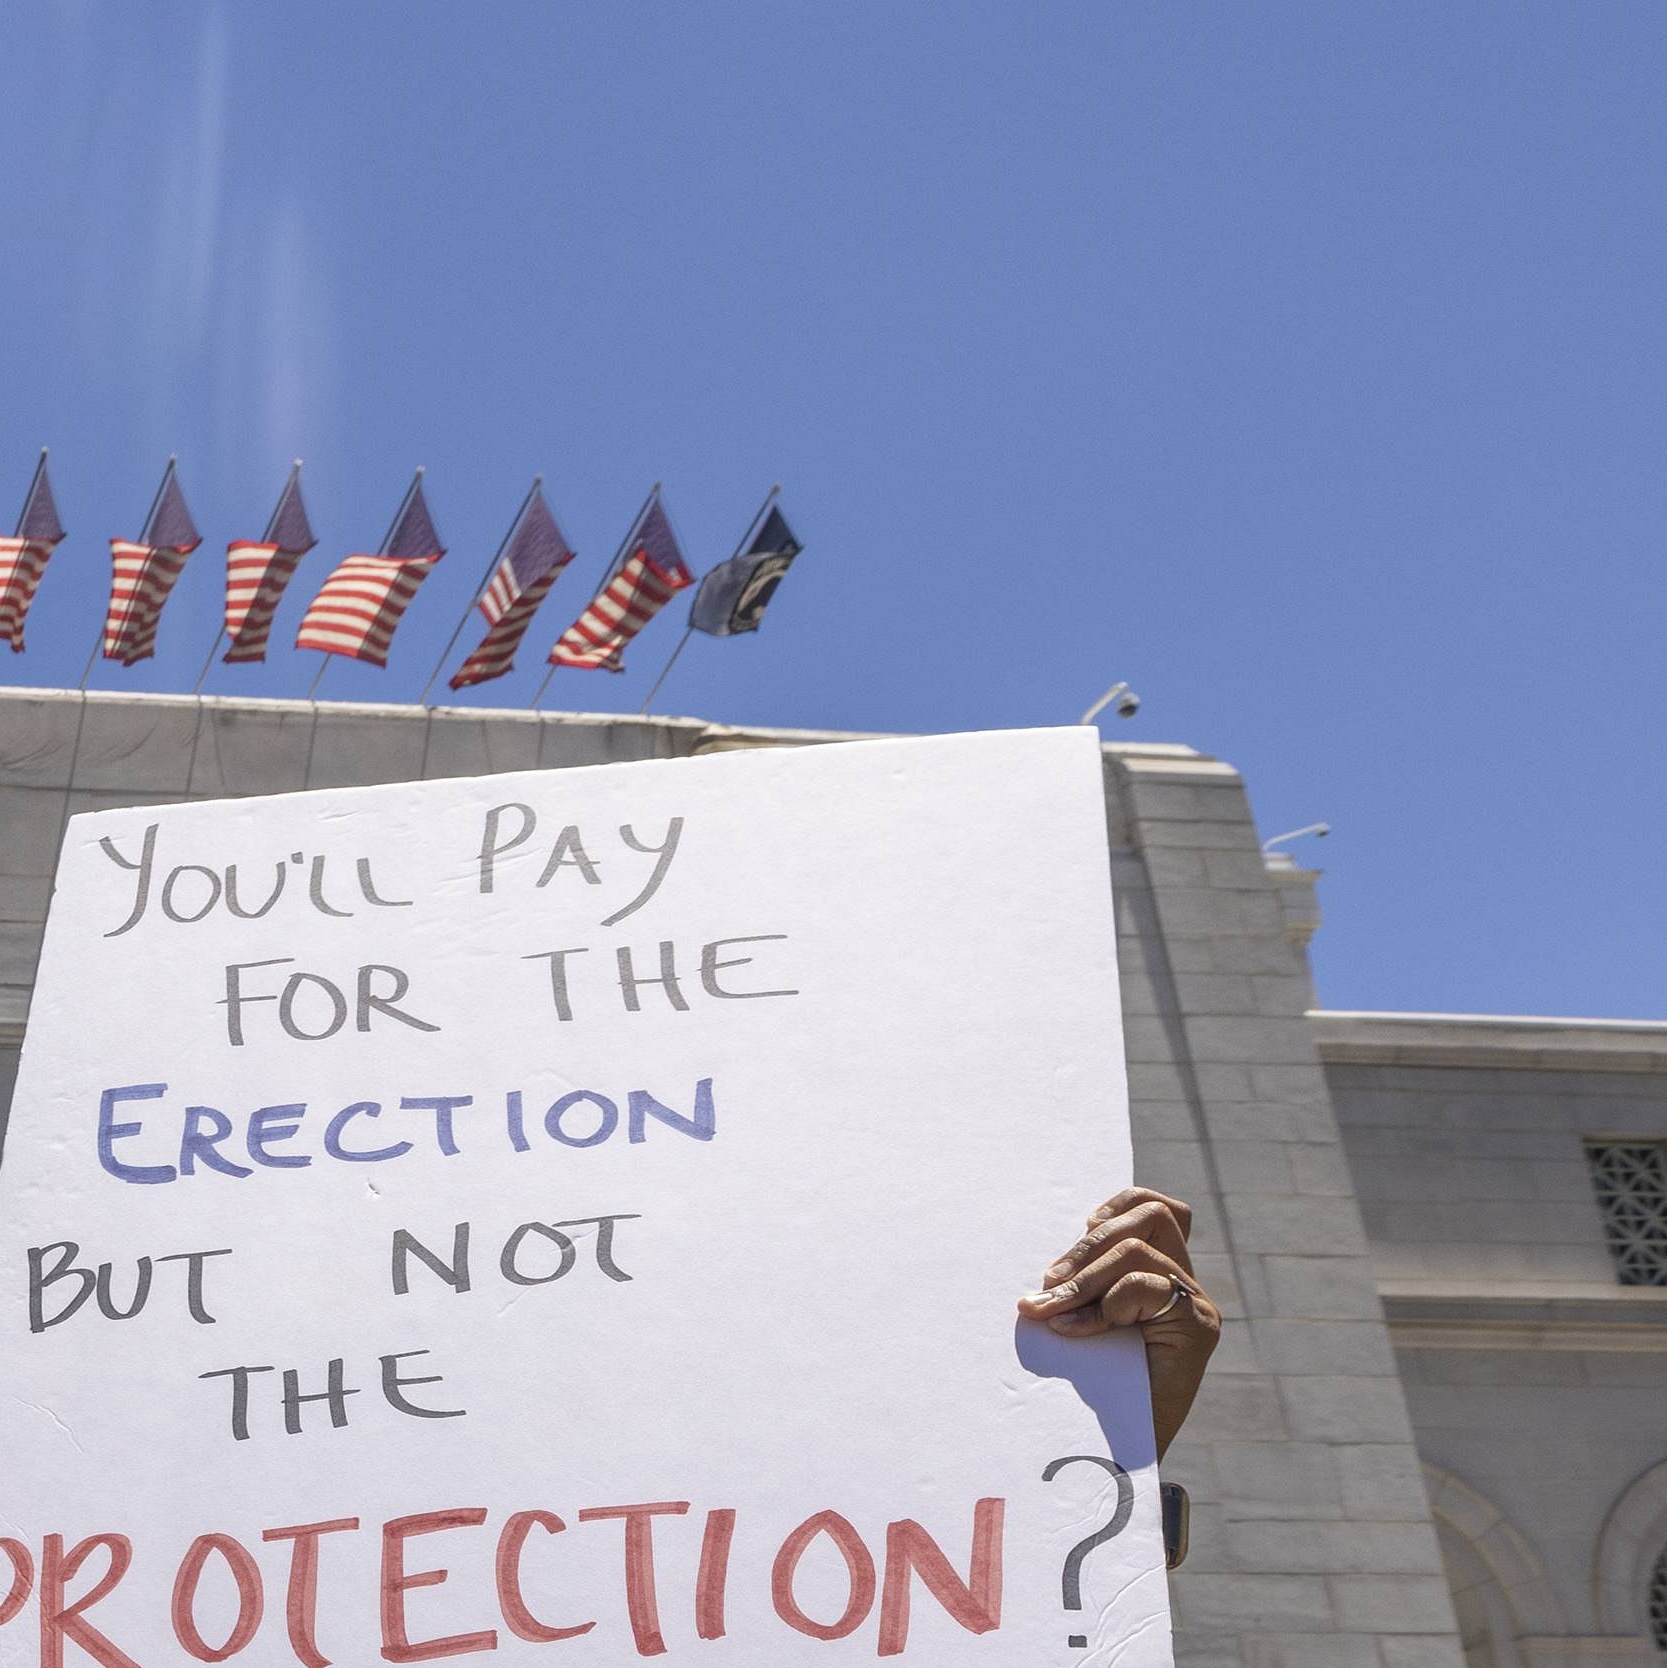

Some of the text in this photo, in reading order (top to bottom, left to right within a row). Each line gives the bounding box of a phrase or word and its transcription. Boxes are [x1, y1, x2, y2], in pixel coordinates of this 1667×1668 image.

[100, 803, 685, 937] YOU'LL PAY
[215, 935, 799, 1046] FOR THE
[97, 1079, 716, 1184] ERECTION
[29, 1214, 642, 1334] BUT NOT
[199, 1350, 467, 1442] THE
